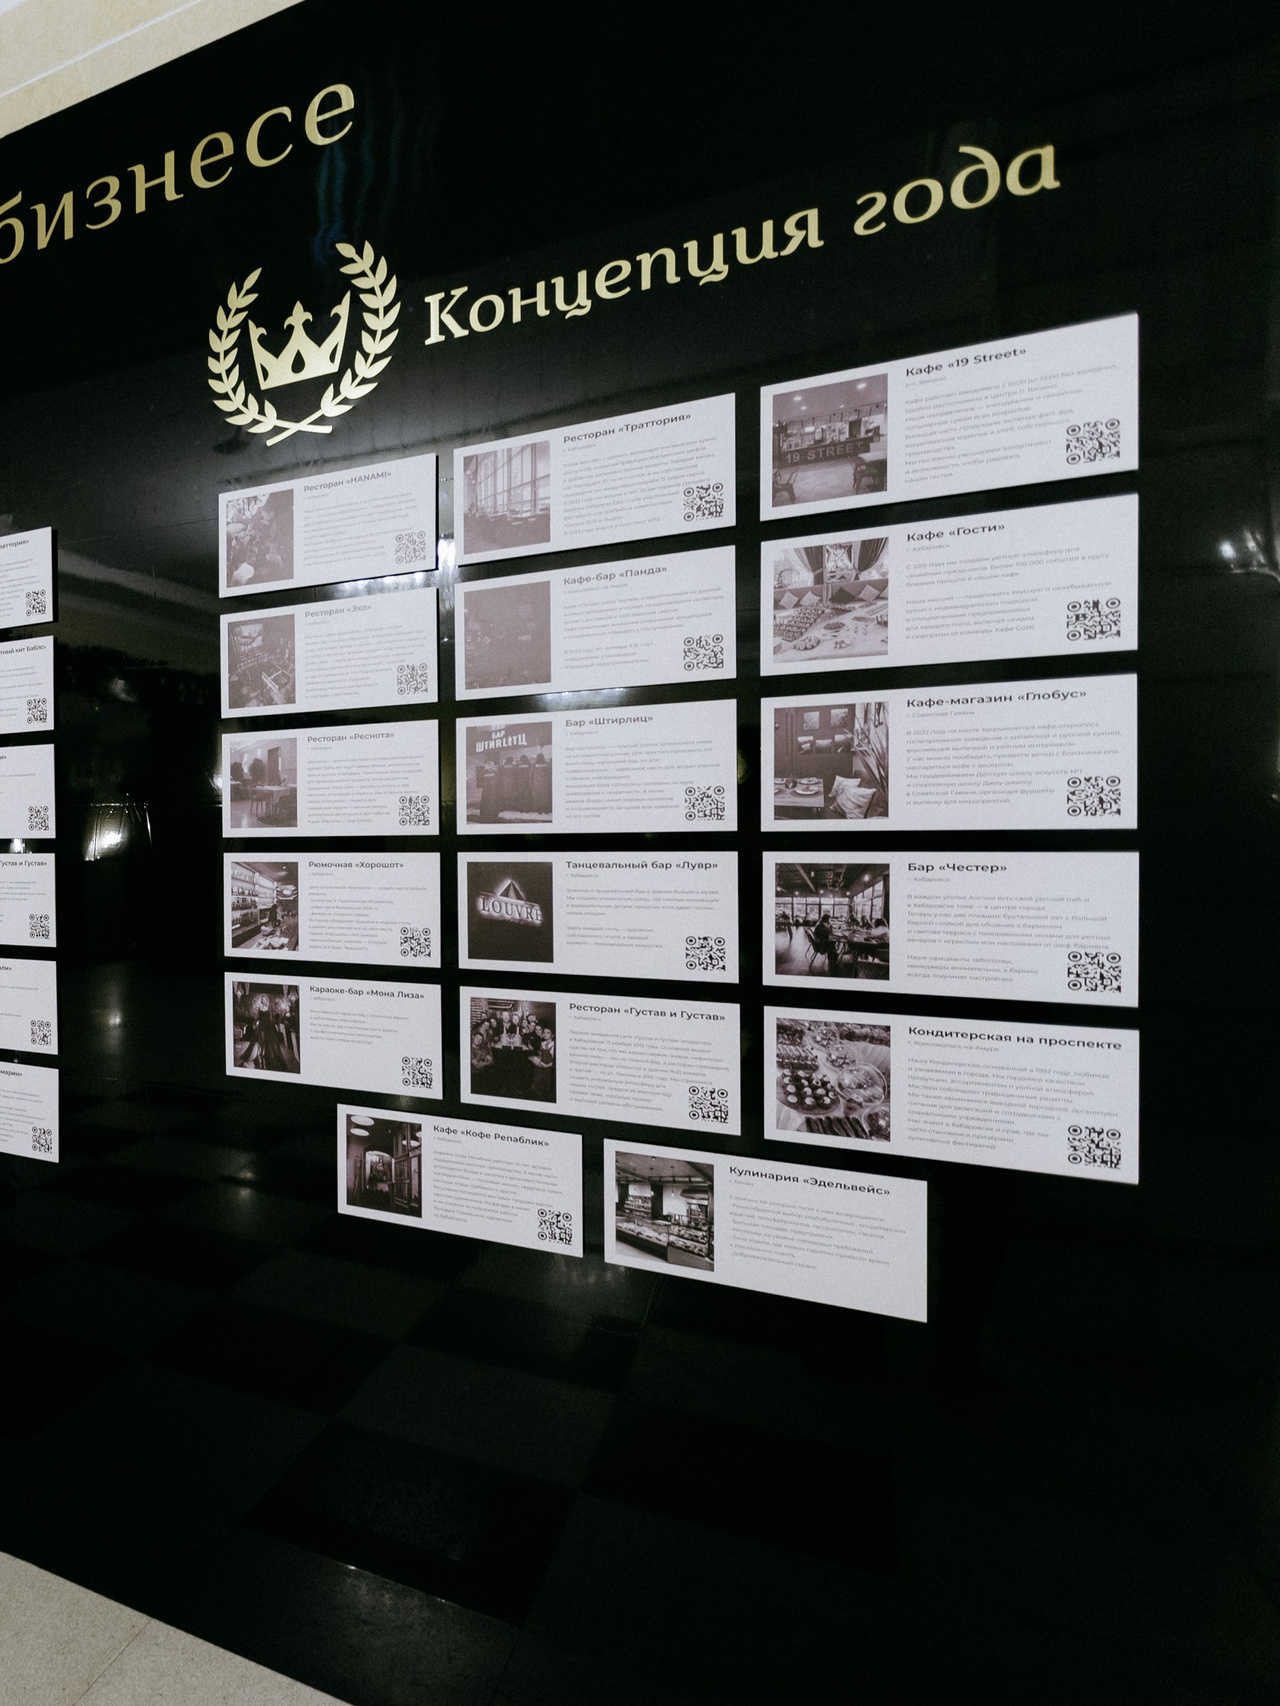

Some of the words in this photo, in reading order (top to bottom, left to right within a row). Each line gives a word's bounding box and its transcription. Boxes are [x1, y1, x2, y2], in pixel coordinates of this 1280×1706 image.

[424, 208, 825, 345] Концепция
[853, 144, 1061, 236] года
[906, 363, 944, 377] Кафе
[947, 357, 970, 368] «19
[973, 348, 1027, 365] Street»
[563, 428, 615, 444] Ресторан
[618, 414, 692, 433] «Траттория»
[785, 452, 801, 463] 19
[806, 441, 864, 460] STREET
[303, 479, 344, 493] Ресторан
[345, 470, 392, 484] «HANAMI»
[906, 530, 944, 542] Кафе
[948, 524, 1005, 536] «Гости»
[563, 572, 617, 586] Кафе-бар
[619, 566, 668, 578] «Панда»
[304, 607, 345, 619] Ресторан
[346, 604, 372, 613] «Эхо»
[906, 695, 1013, 709] Кафе-магазин
[1017, 689, 1087, 701] «Глобус»
[565, 719, 586, 728] Бар
[588, 715, 654, 726] «Штирлиц»
[306, 735, 348, 744] Ресторан
[349, 732, 395, 741] «Реснота»
[24, 859, 48, 868] Густав»
[308, 860, 353, 869] Рюмочная
[354, 861, 404, 870] «Хорошот»
[565, 860, 648, 870] Танцевальный
[651, 860, 673, 871] бар
[675, 860, 719, 871] «Лувр»
[907, 862, 935, 874] Бар
[938, 863, 1007, 874] «Честер»
[480, 896, 543, 922] LOUVRE
[309, 985, 365, 997] Караоке-бар
[365, 989, 395, 998] «Мона
[396, 990, 425, 1000] Лиза»
[569, 1002, 621, 1015] Ресторан
[623, 1006, 667, 1017] «Густав
[680, 1010, 726, 1021] Густав»
[908, 1026, 1012, 1042] Кондитерская
[1016, 1035, 1034, 1044] на
[1038, 1037, 1122, 1050] проспекте
[433, 1124, 459, 1136] Кафе
[460, 1129, 492, 1140] «Кофе
[493, 1132, 550, 1147] Репаблик»
[729, 1165, 799, 1184] Кулинария
[802, 1177, 891, 1195] «Эдельвейс»
